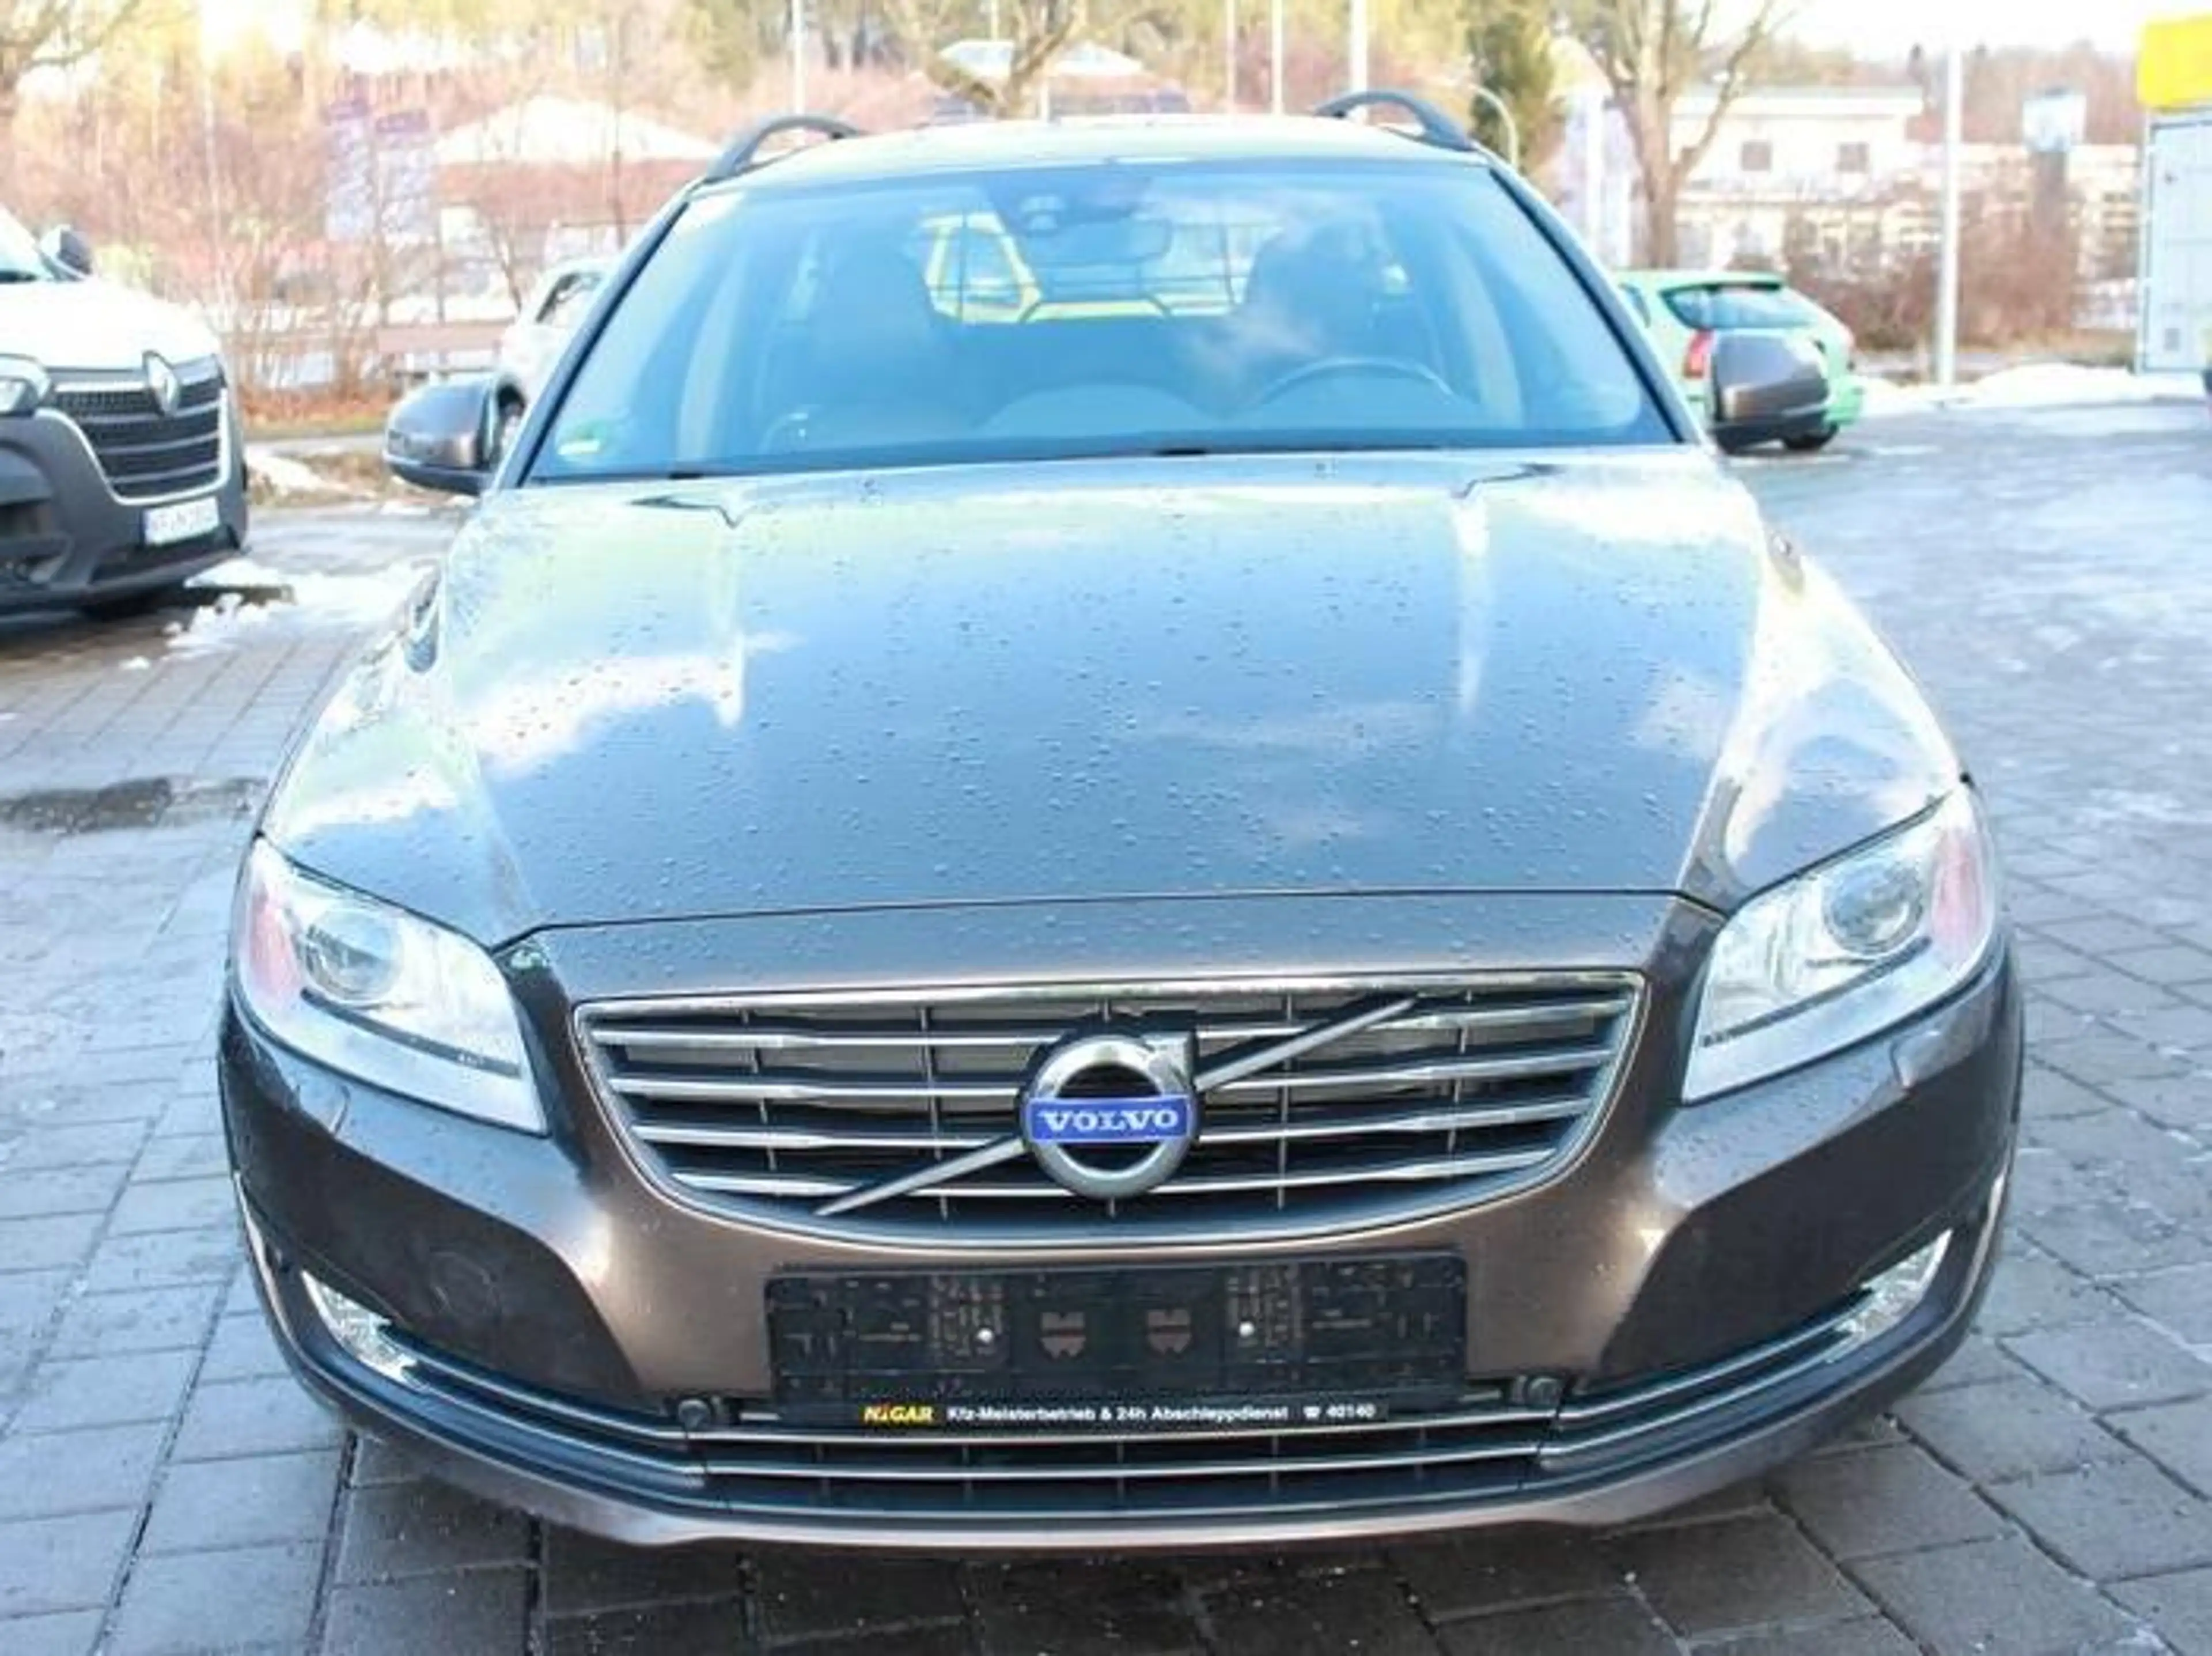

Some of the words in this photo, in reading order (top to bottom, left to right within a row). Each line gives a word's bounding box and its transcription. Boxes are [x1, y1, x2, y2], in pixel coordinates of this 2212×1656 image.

[1037, 1109, 1179, 1132] VOLVO
[946, 1406, 1094, 1421] Kfz-Meisterbetrieb
[1100, 1407, 1111, 1420] &
[1116, 1406, 1146, 1420] 24h
[1152, 1405, 1288, 1423] Abschleppdienst
